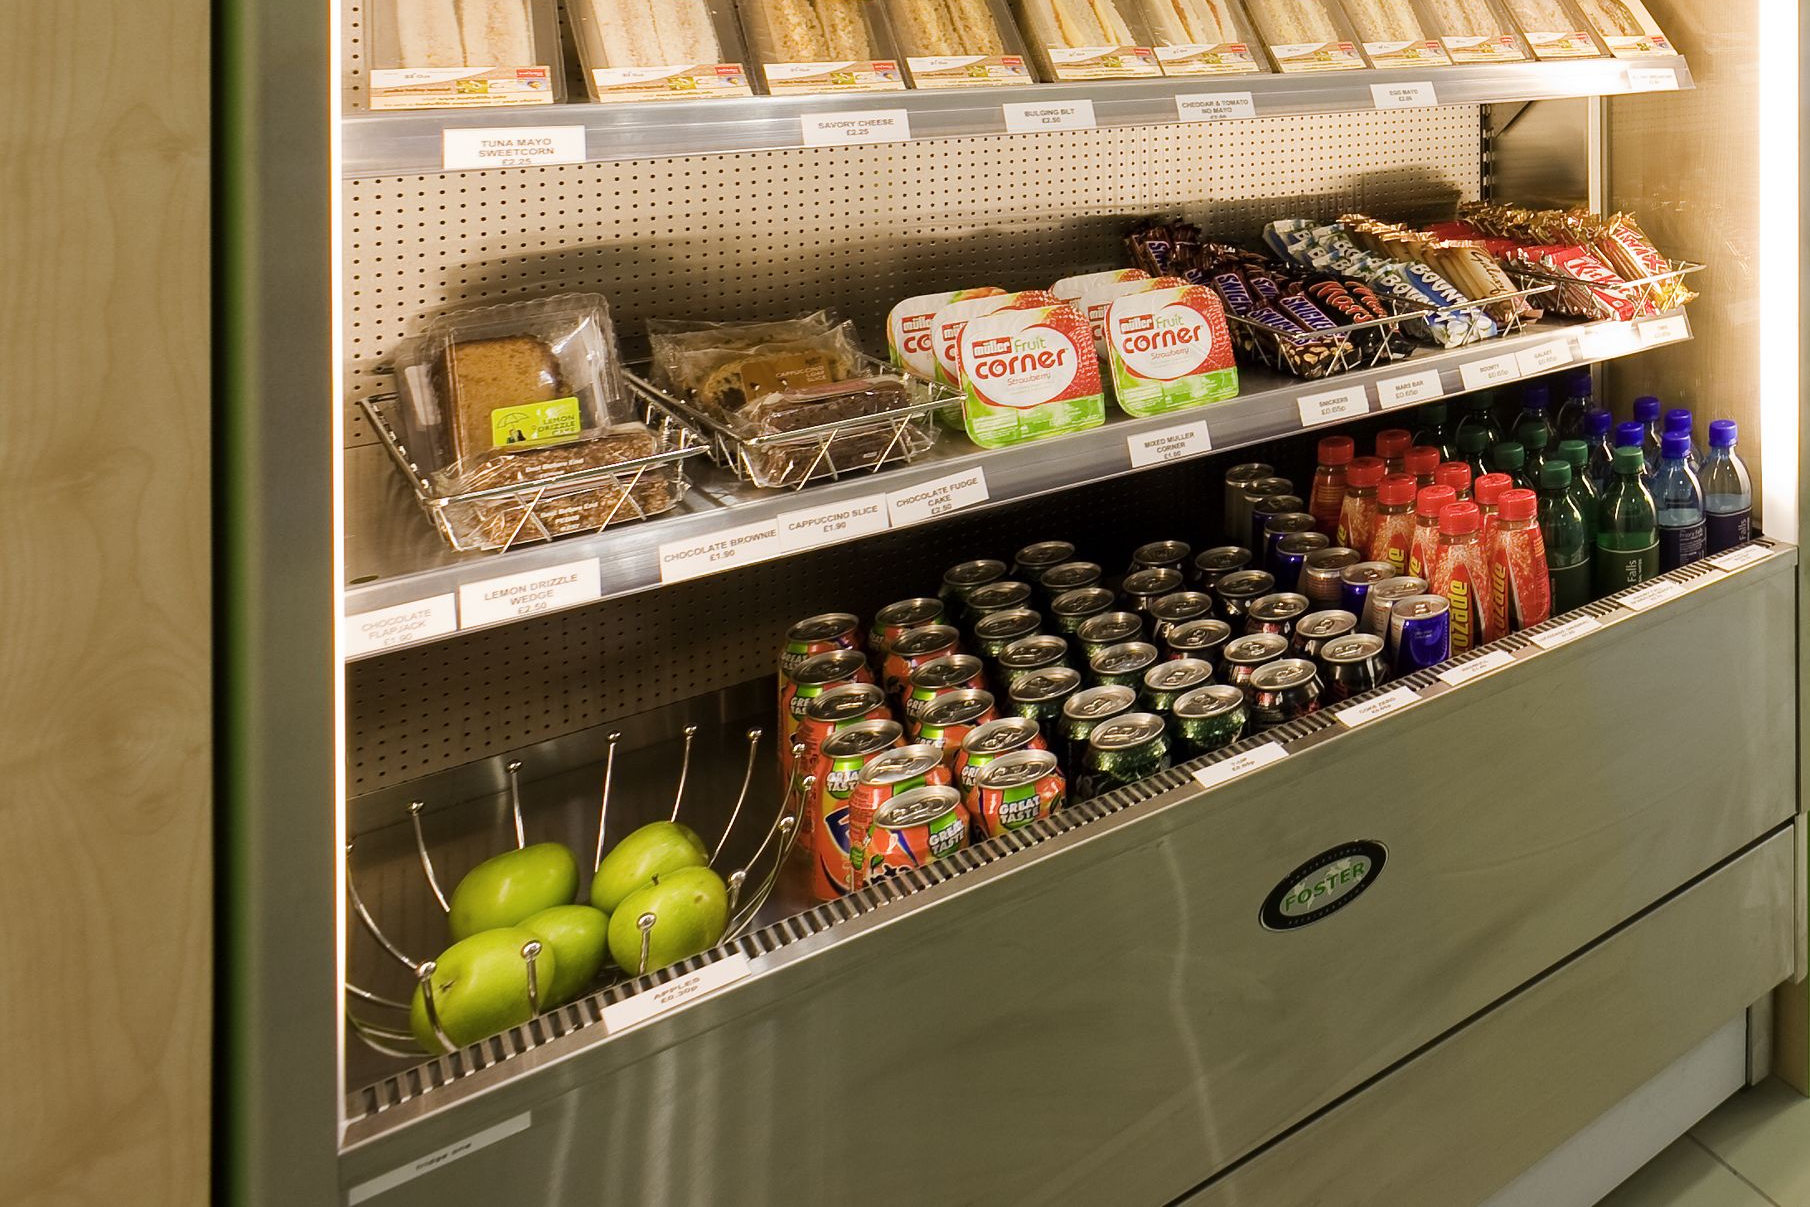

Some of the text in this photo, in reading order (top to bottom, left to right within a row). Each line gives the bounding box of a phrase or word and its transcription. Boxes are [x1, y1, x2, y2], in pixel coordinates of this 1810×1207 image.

[1182, 99, 1249, 109] CHEDDAR TOMATO
[1024, 108, 1076, 118] BULGING BLT
[818, 119, 894, 130] SAVORY CHEESE
[846, 128, 870, 136] £2.25
[480, 137, 552, 149] TUNA MAYO
[478, 146, 555, 158] SWEETCORN
[1120, 318, 1154, 334] müller
[1154, 314, 1185, 330] Fruit
[1014, 337, 1047, 354] Fruit
[1122, 325, 1202, 355] corner
[973, 342, 1011, 357] müller
[1151, 348, 1190, 361] Strawberry
[975, 348, 1066, 380] corner
[1007, 372, 1051, 387] Strawberry
[1318, 395, 1349, 408] SNICKERS
[1144, 431, 1196, 449] MIXED MULLER
[1156, 441, 1186, 454] CORNER
[896, 477, 978, 508] CHOCOLATE FUDGE
[927, 494, 952, 508] CAKE
[788, 504, 879, 532] CAPPUCCINO SLICE
[1739, 519, 1747, 541] Falls
[663, 528, 777, 564] CHOCOLATE BROWNIE
[1627, 559, 1638, 583] Falls
[484, 573, 579, 602] LEMON DRIZZLE
[510, 589, 555, 606] WEDGE
[517, 602, 548, 615] £2.50
[361, 608, 432, 631] CHOCOLATE
[368, 620, 426, 640] FLAPJACK
[999, 796, 1040, 815] GREAT
[1000, 806, 1040, 825] TASTE
[931, 828, 965, 855] TASTE
[1284, 860, 1366, 913] FOSTER
